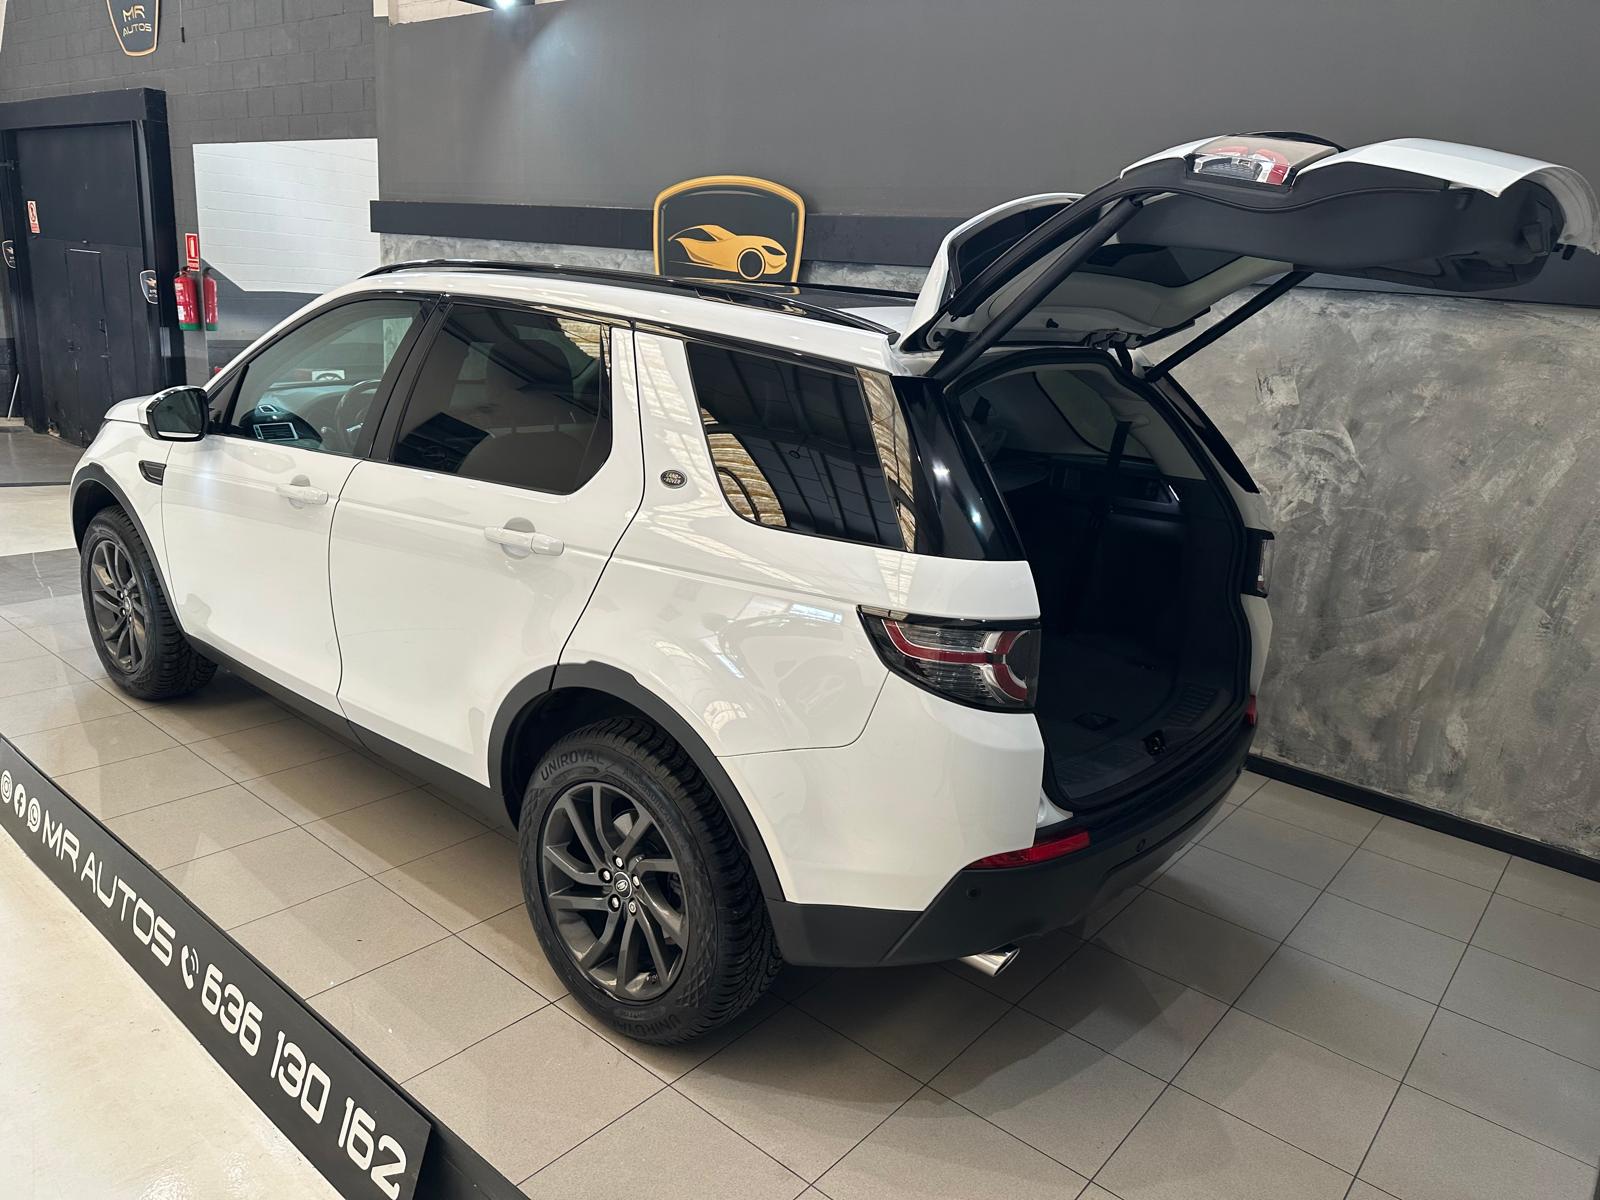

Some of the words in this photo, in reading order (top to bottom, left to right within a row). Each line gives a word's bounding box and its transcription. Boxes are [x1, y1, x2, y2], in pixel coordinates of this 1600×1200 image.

[122, 5, 146, 22] MR
[122, 22, 152, 38] AUTOS
[540, 749, 604, 782] UNIROYAL
[42, 809, 80, 873] MR
[81, 851, 176, 967] AUTOS
[201, 963, 263, 1056] 636
[270, 1030, 332, 1124] 130
[338, 1096, 407, 1200] 162
